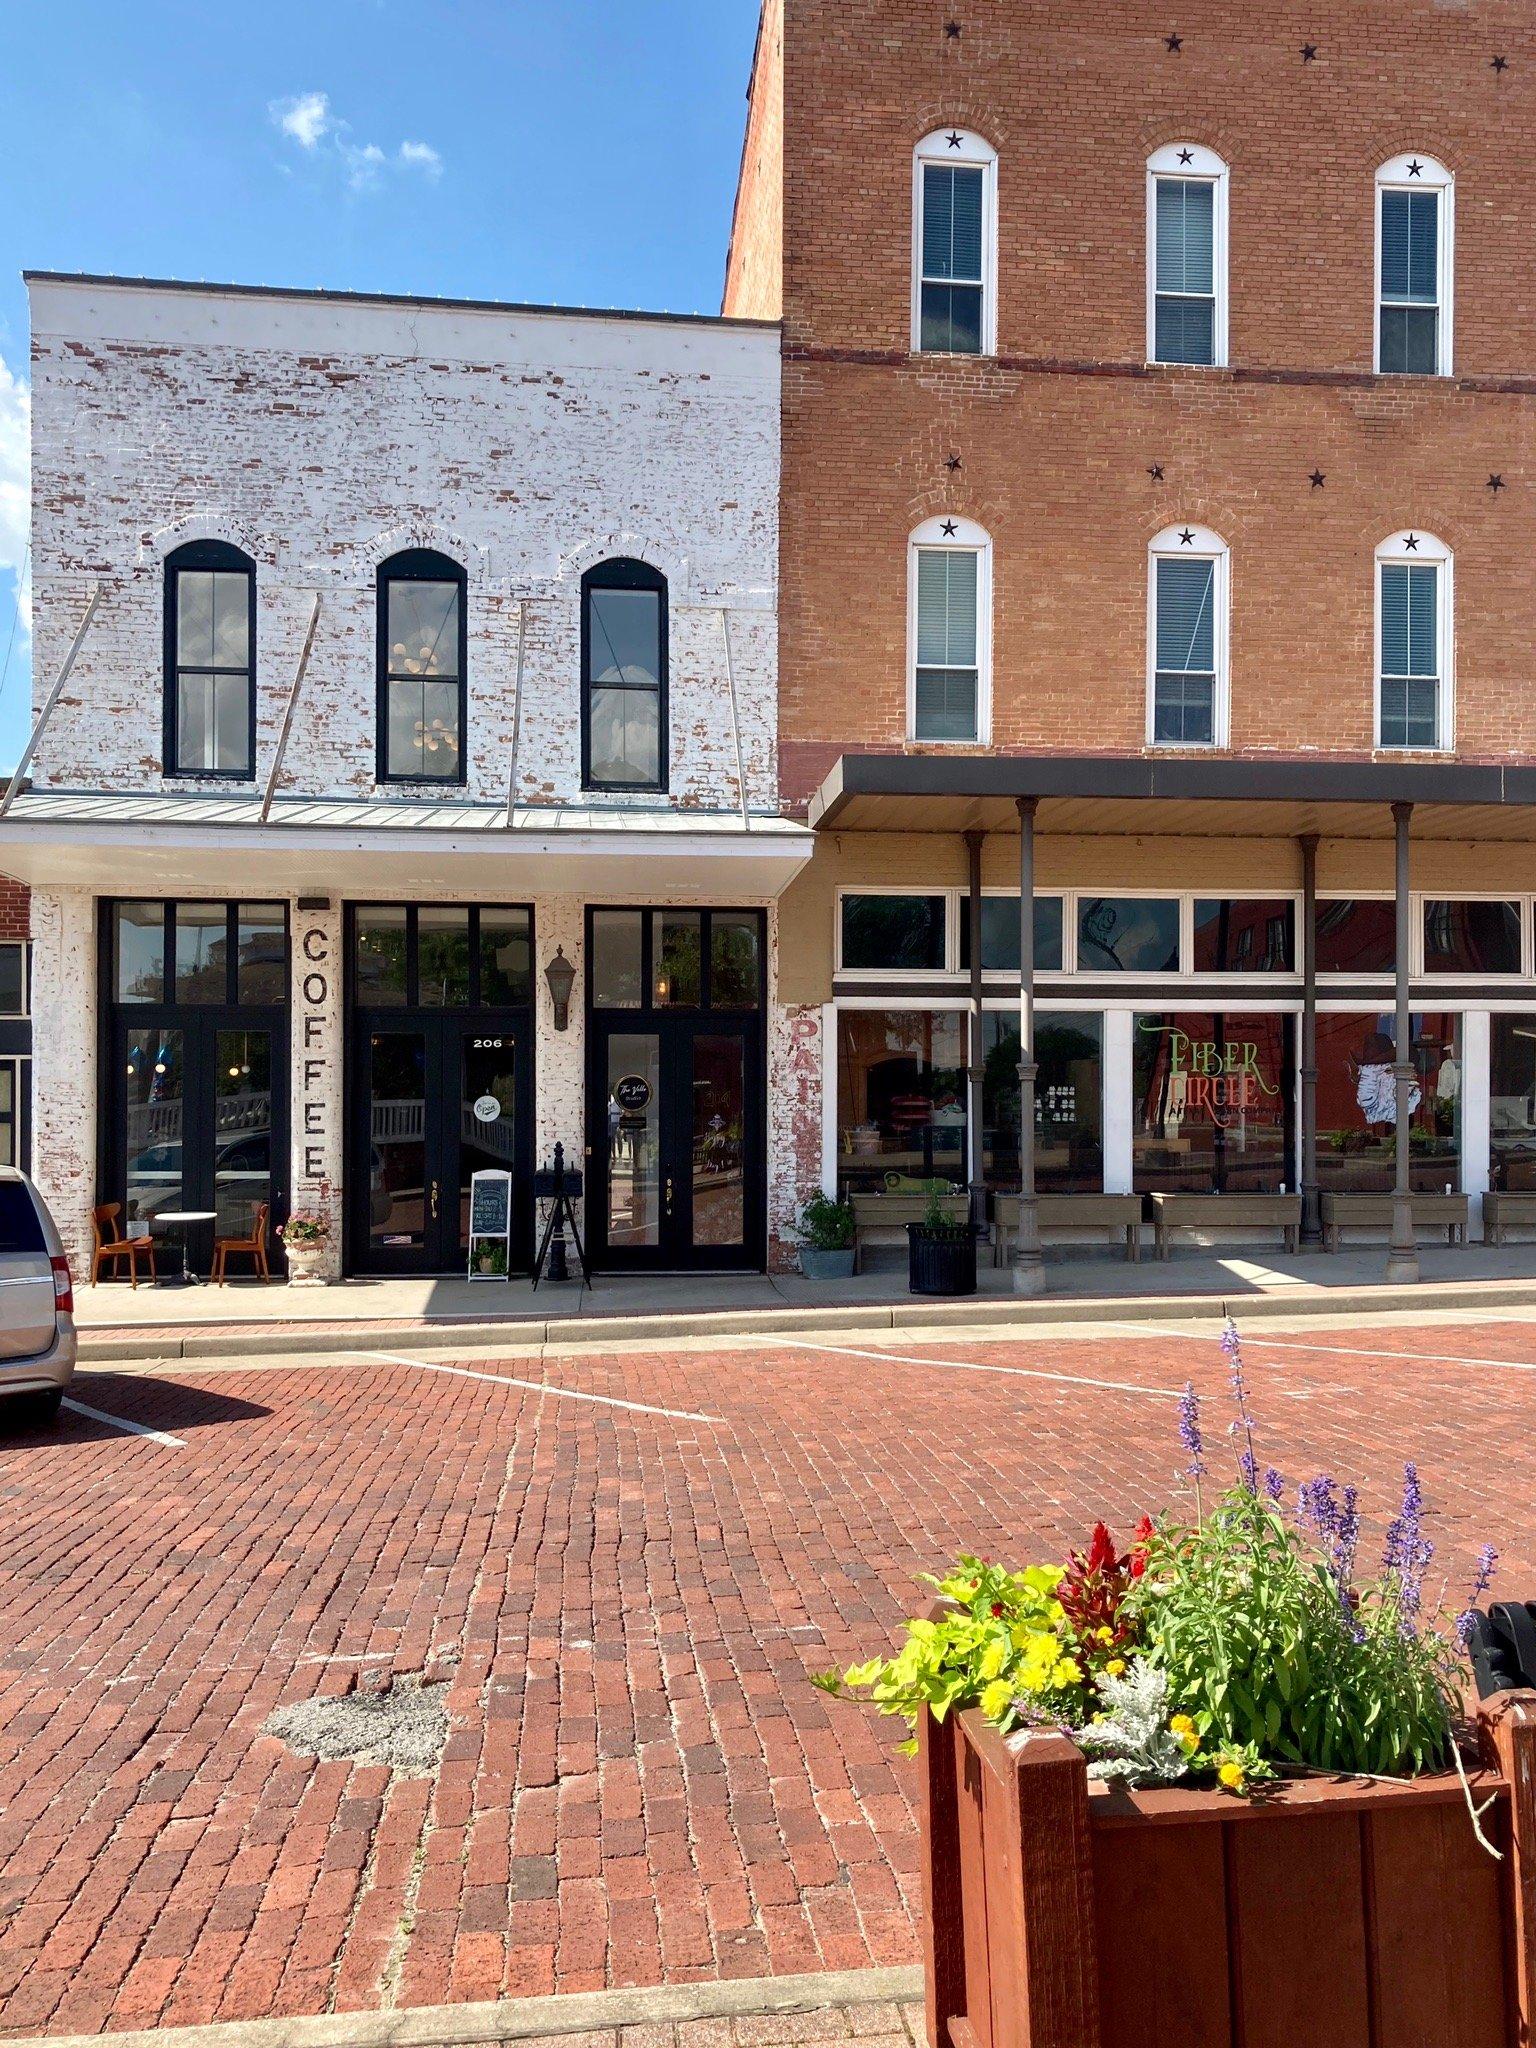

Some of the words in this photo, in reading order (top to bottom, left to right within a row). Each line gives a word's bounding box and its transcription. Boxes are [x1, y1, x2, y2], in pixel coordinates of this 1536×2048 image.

[303, 928, 328, 1179] COFFEE
[473, 1039, 502, 1048] 206
[476, 1103, 496, 1116] Open
[1170, 1077, 1258, 1128] CIRCLE
